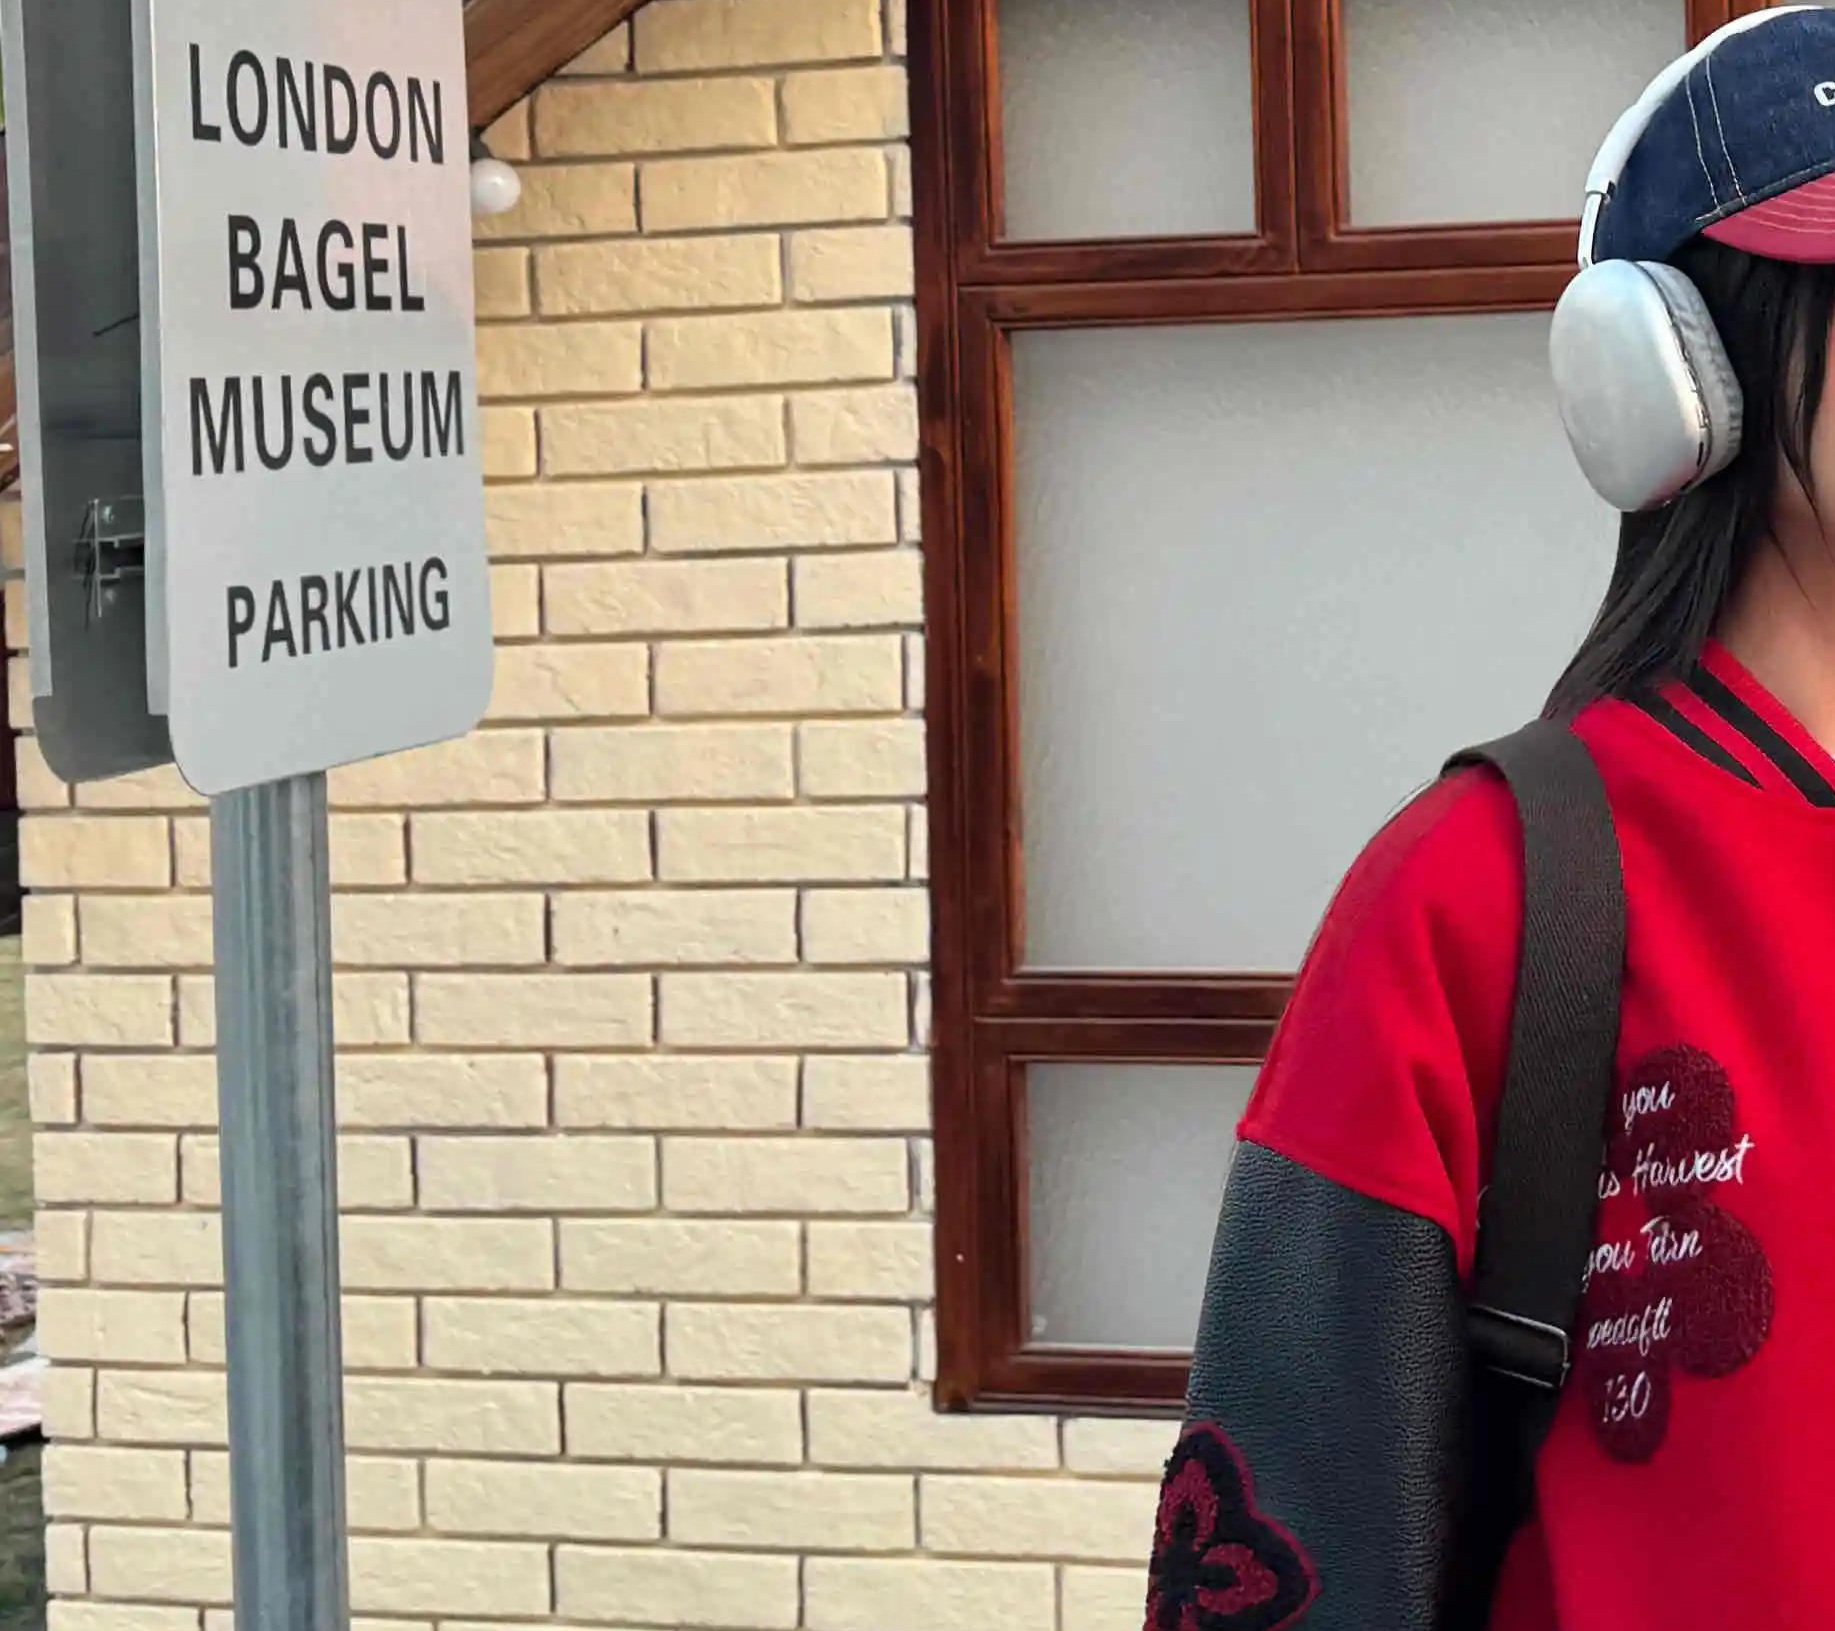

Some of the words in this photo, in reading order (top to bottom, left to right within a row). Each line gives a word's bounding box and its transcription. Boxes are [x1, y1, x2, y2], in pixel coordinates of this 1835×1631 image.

[189, 43, 444, 164] LONDON
[227, 214, 425, 312] BAGEL
[189, 370, 464, 476] MUSEUM
[227, 557, 450, 668] PARKING
[1632, 1133, 1756, 1197] Harvest
